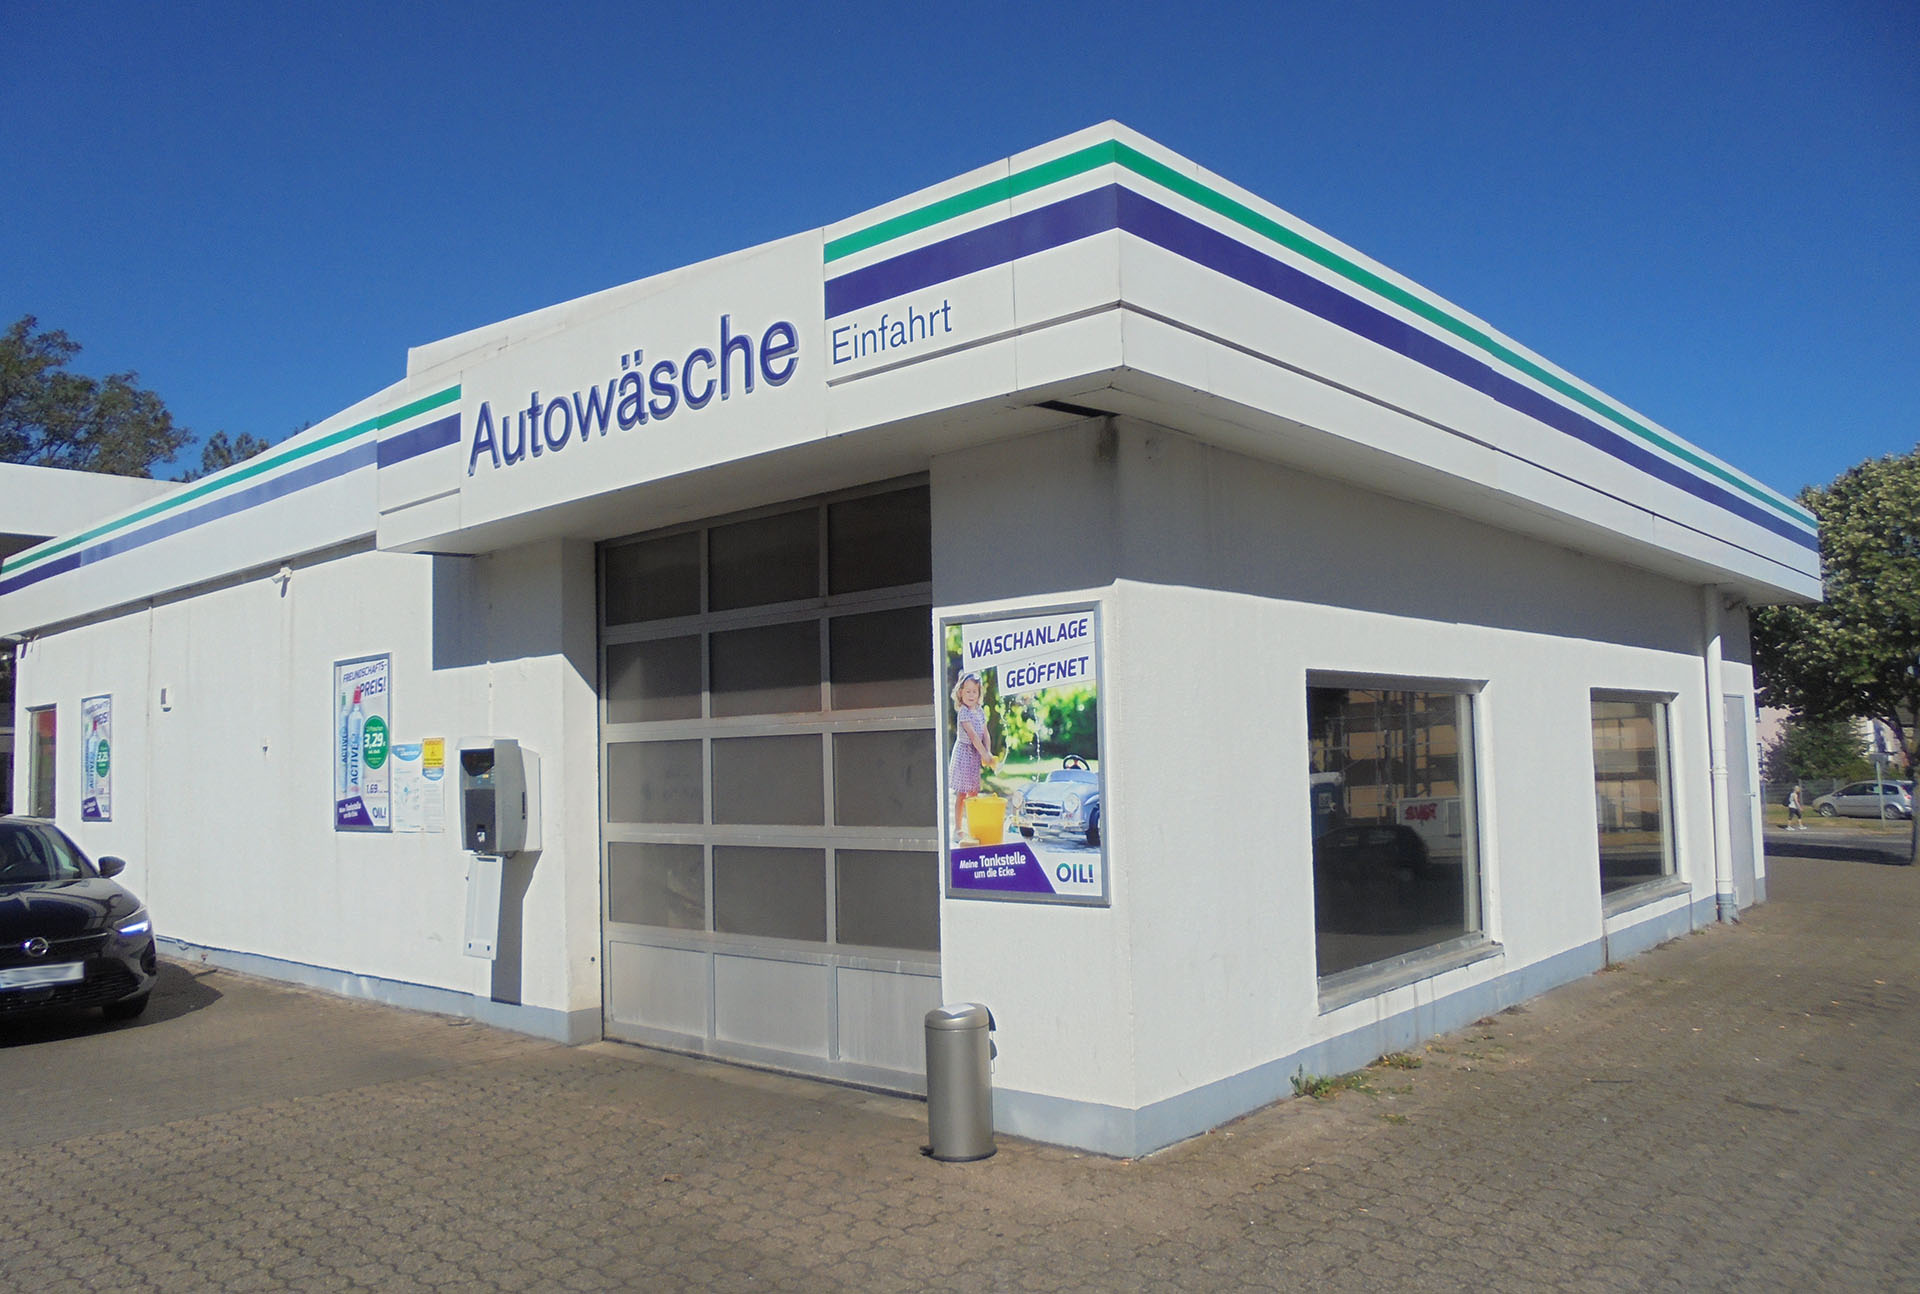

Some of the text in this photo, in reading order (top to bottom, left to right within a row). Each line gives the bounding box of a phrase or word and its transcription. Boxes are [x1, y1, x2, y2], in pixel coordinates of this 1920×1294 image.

[832, 299, 952, 365] Einfahrt
[468, 314, 800, 477] Autowäsche
[969, 618, 1088, 659] WASCHANLAGE
[1006, 656, 1089, 688] GEÖFFNET
[960, 852, 1027, 869] Meine Tankstelle
[974, 866, 1016, 879] um die Ecke.
[1056, 862, 1094, 883] OIL!
